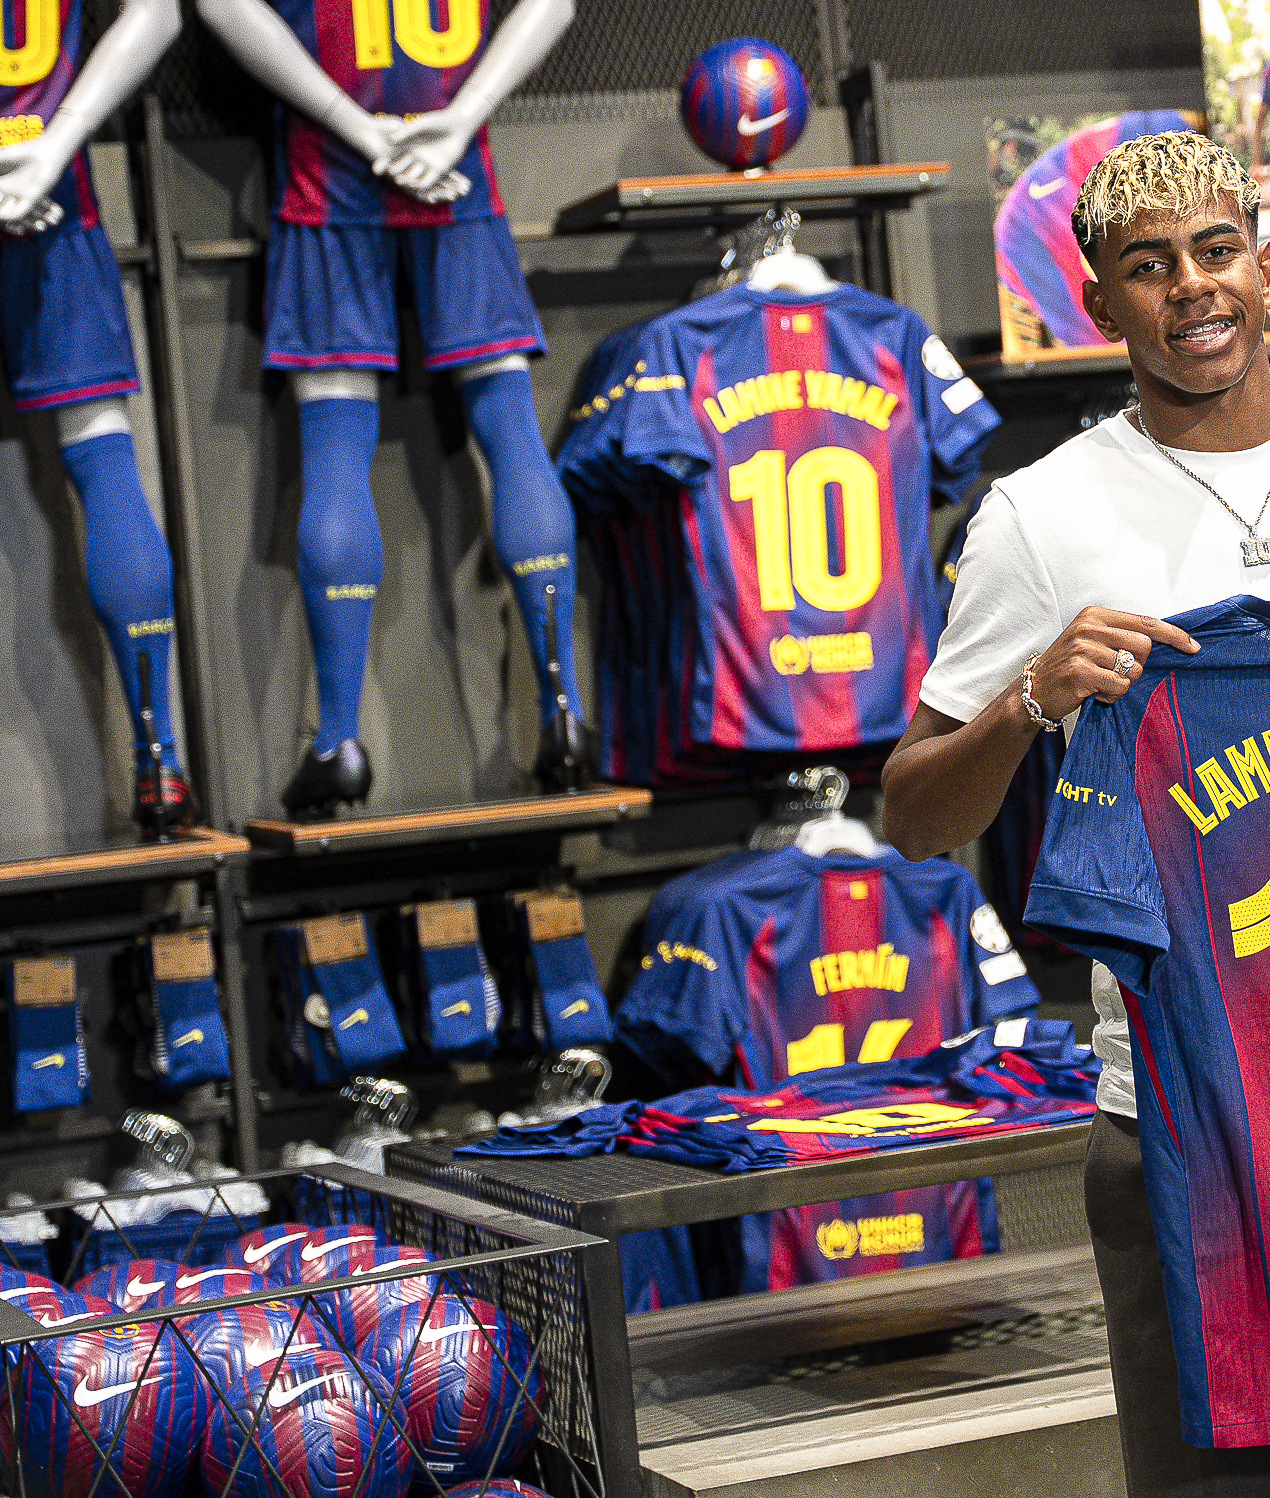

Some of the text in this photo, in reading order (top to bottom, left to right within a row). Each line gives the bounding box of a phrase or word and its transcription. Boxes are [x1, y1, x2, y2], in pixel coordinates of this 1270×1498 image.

[728, 445, 884, 613] 10
[1097, 791, 1118, 807] tv
[809, 943, 911, 997] FERMÍN
